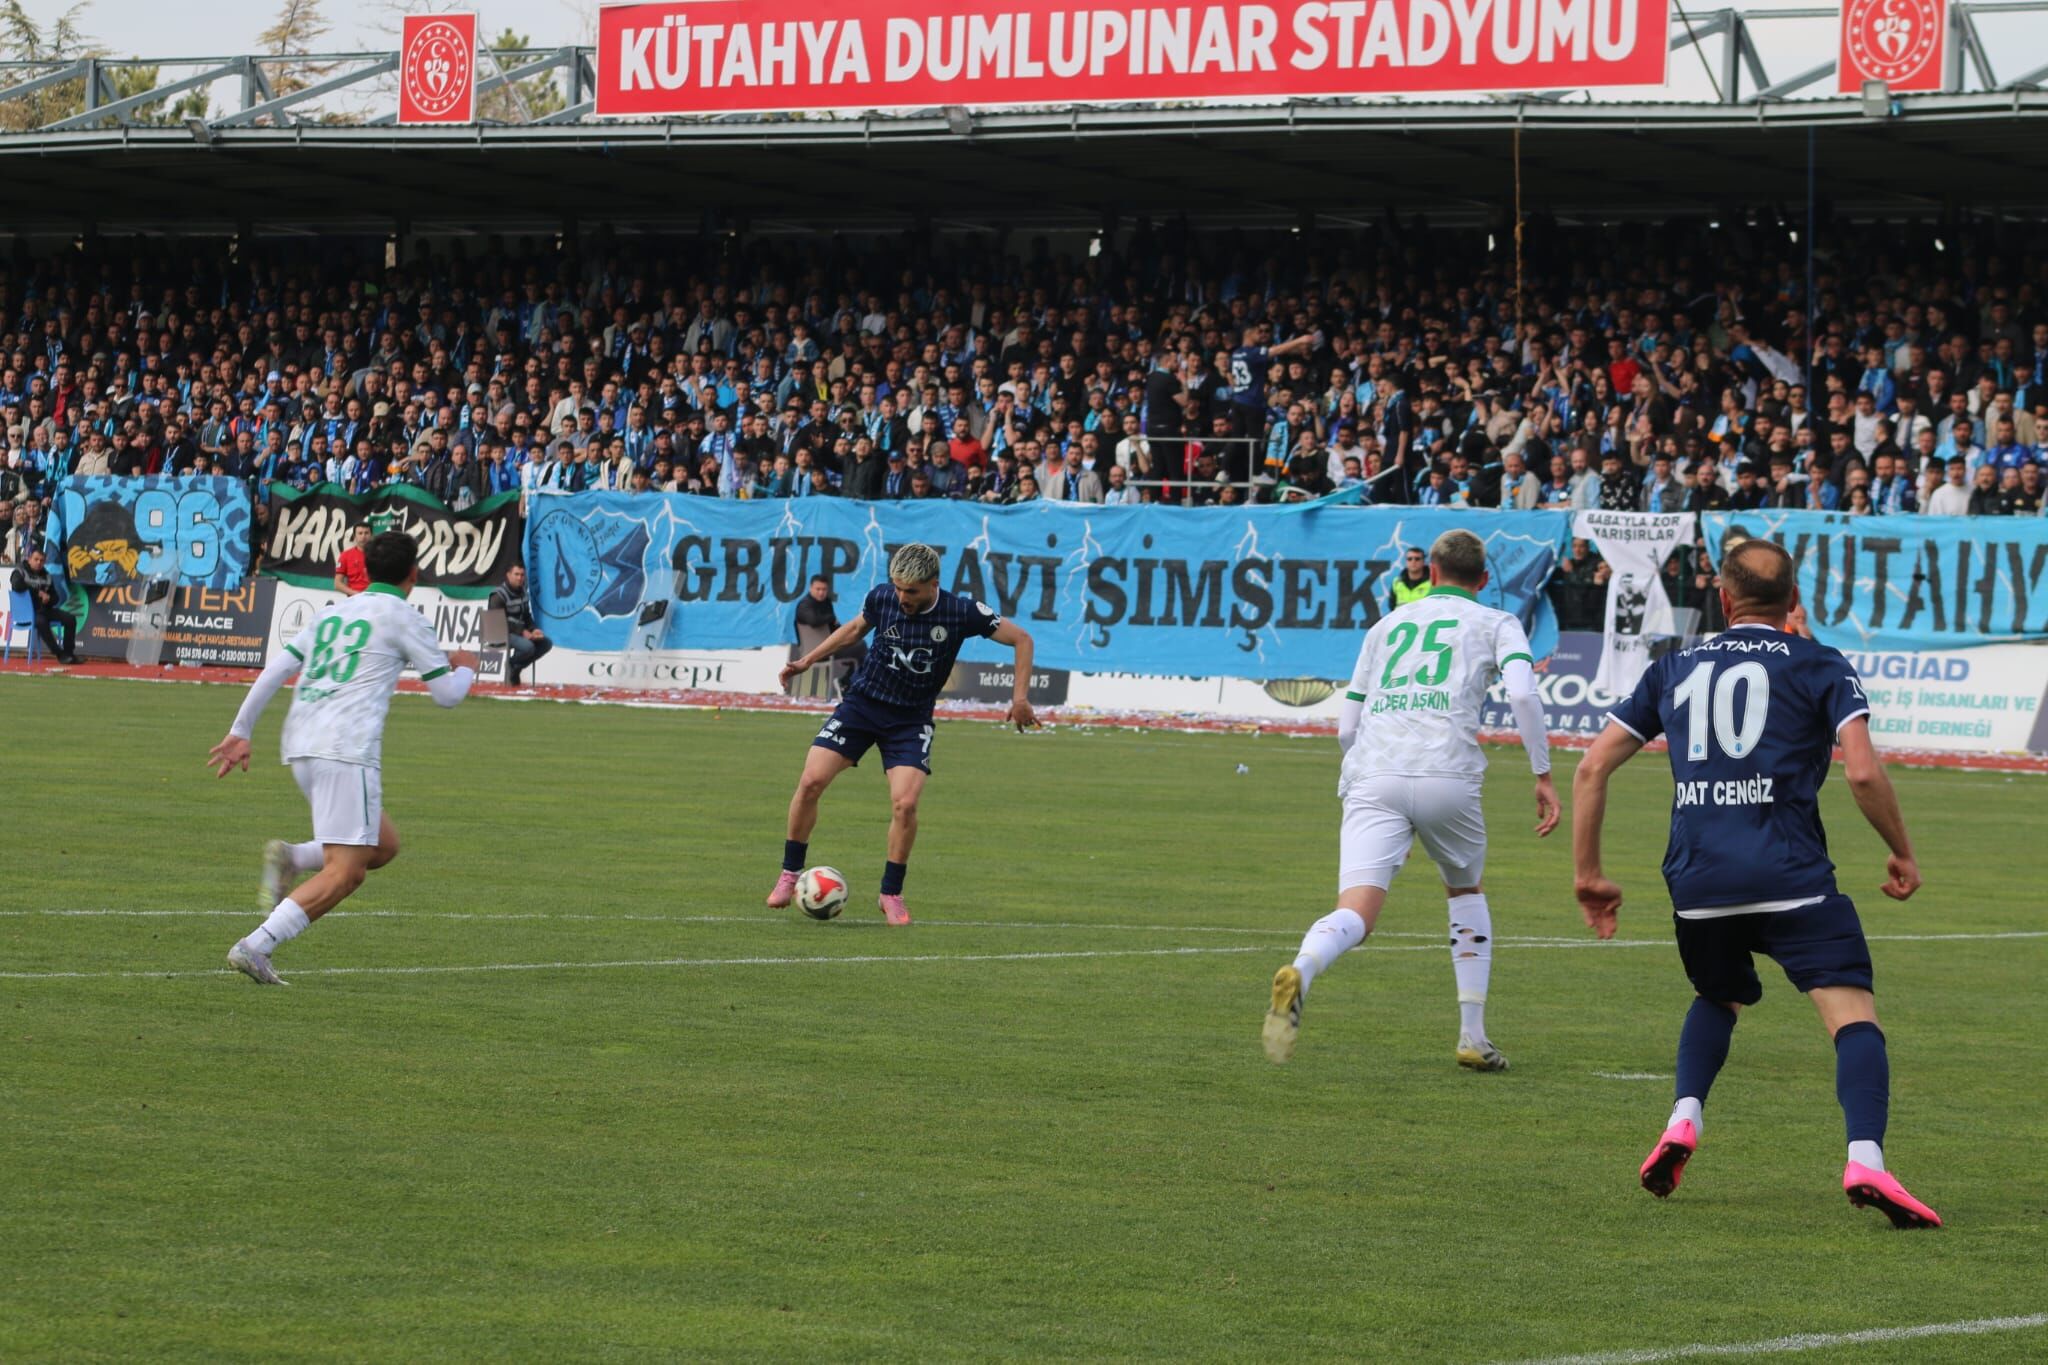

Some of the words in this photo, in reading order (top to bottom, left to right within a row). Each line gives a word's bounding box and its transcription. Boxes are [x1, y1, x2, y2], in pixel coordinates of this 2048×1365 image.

[619, 15, 870, 92] KÜTAHYA
[884, 4, 1278, 83] DUMLUPINAR
[1290, 0, 1638, 71] STADYUMU
[133, 488, 221, 577] 96
[1593, 527, 1676, 542] YARIŞIRLAR
[1652, 516, 1681, 527] ZOR
[1773, 514, 2048, 635] KÜTAHY
[672, 534, 861, 604] GRUP
[1084, 533, 1391, 653] ŞİMŞEK
[174, 614, 234, 630] PALACE
[305, 615, 372, 684] 83
[887, 646, 935, 674] NG
[1381, 619, 1459, 690] 25
[588, 660, 728, 688] concept
[1410, 690, 1450, 712] AŞKIN
[1673, 660, 1770, 762] 10
[1896, 686, 1914, 709] İŞ
[1917, 688, 2008, 711] İNSANLARI
[2013, 696, 2037, 711] VE
[1917, 718, 1993, 738] DERNEĞİ
[1712, 773, 1774, 805] CENGİZ
